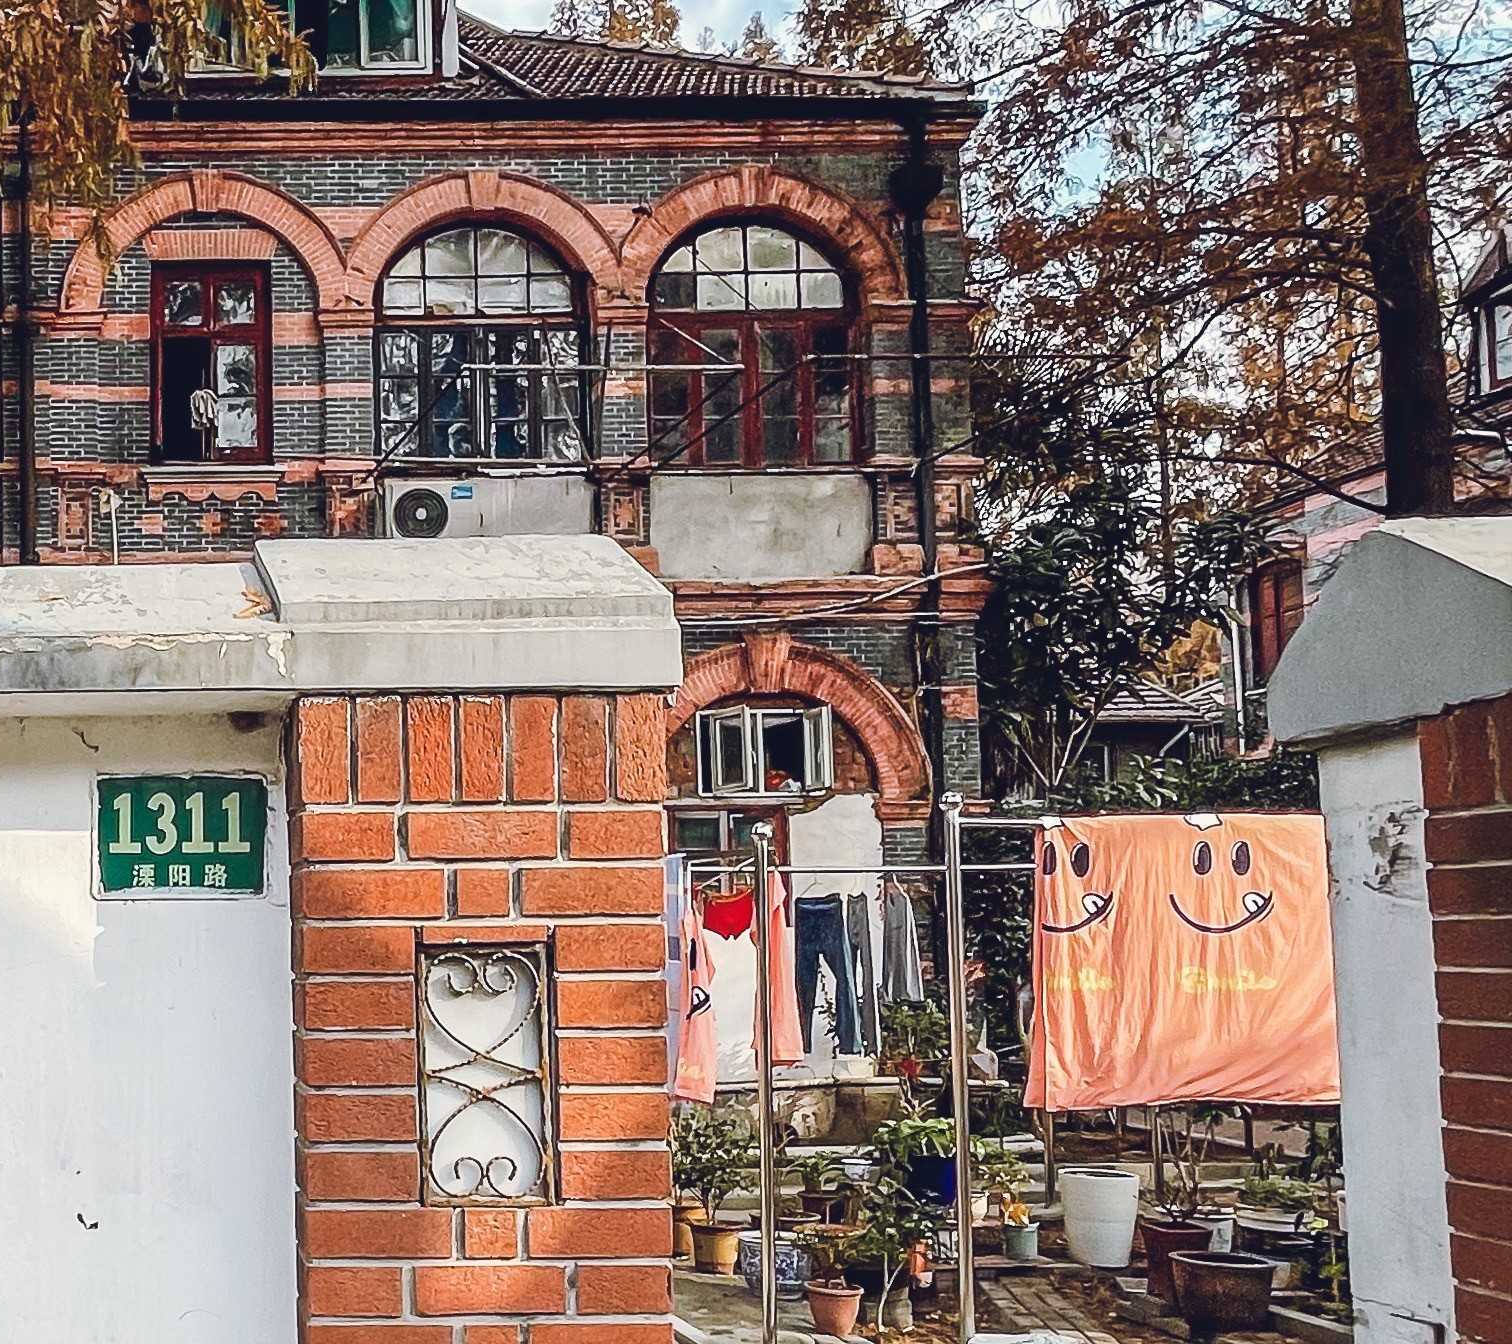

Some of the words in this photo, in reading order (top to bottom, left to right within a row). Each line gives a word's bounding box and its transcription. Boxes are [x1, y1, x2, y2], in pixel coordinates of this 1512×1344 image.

[109, 791, 251, 855] 1311
[132, 863, 228, 887] 溧阳路
